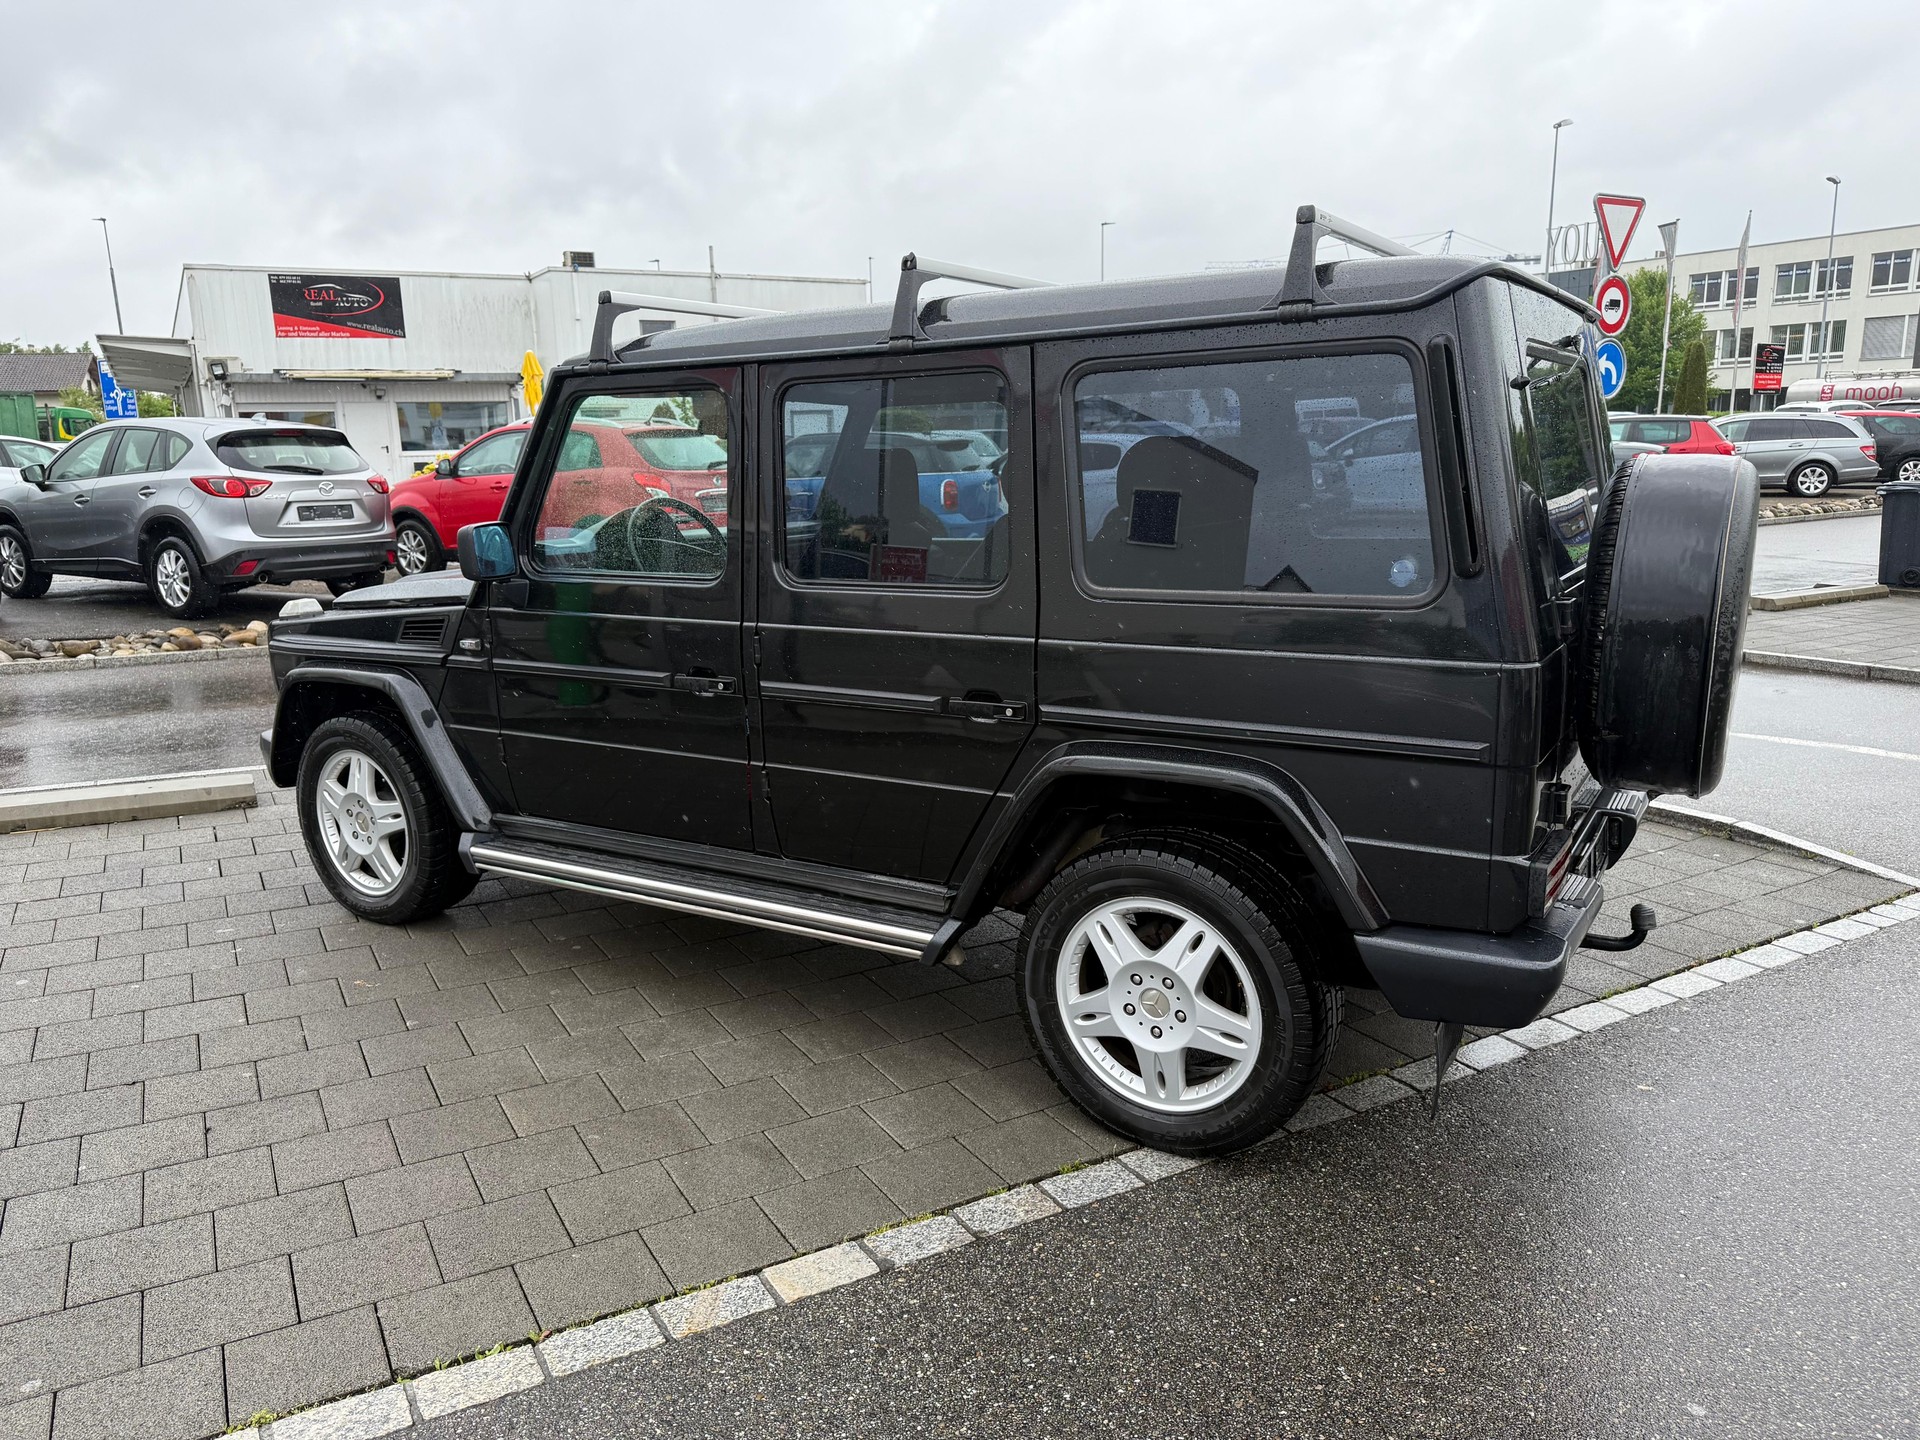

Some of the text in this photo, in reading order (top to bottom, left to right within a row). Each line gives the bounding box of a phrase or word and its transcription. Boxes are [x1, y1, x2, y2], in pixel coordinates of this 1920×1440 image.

[303, 289, 338, 301] REAL
[335, 297, 369, 307] AUTO
[346, 321, 404, 337] www.realauto.ch
[1845, 382, 1903, 401] mooh
